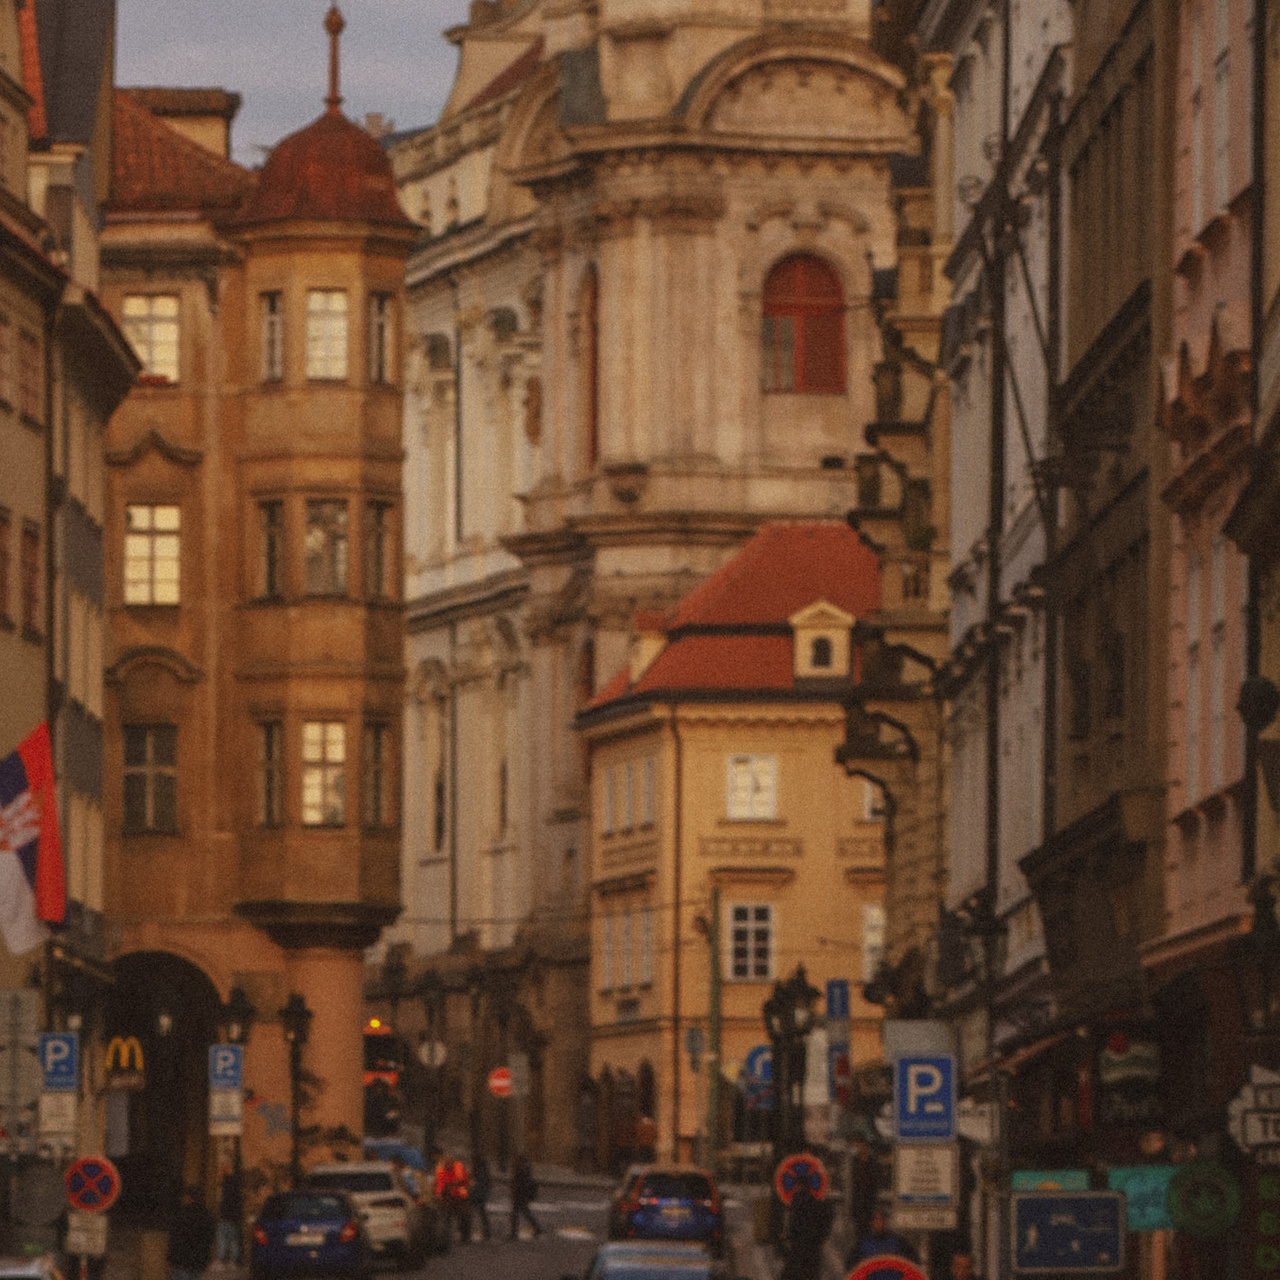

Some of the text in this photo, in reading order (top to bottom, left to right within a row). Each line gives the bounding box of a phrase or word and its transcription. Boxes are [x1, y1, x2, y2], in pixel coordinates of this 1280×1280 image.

[45, 1039, 70, 1072] P
[216, 1049, 235, 1075] P
[907, 1063, 943, 1115] P
